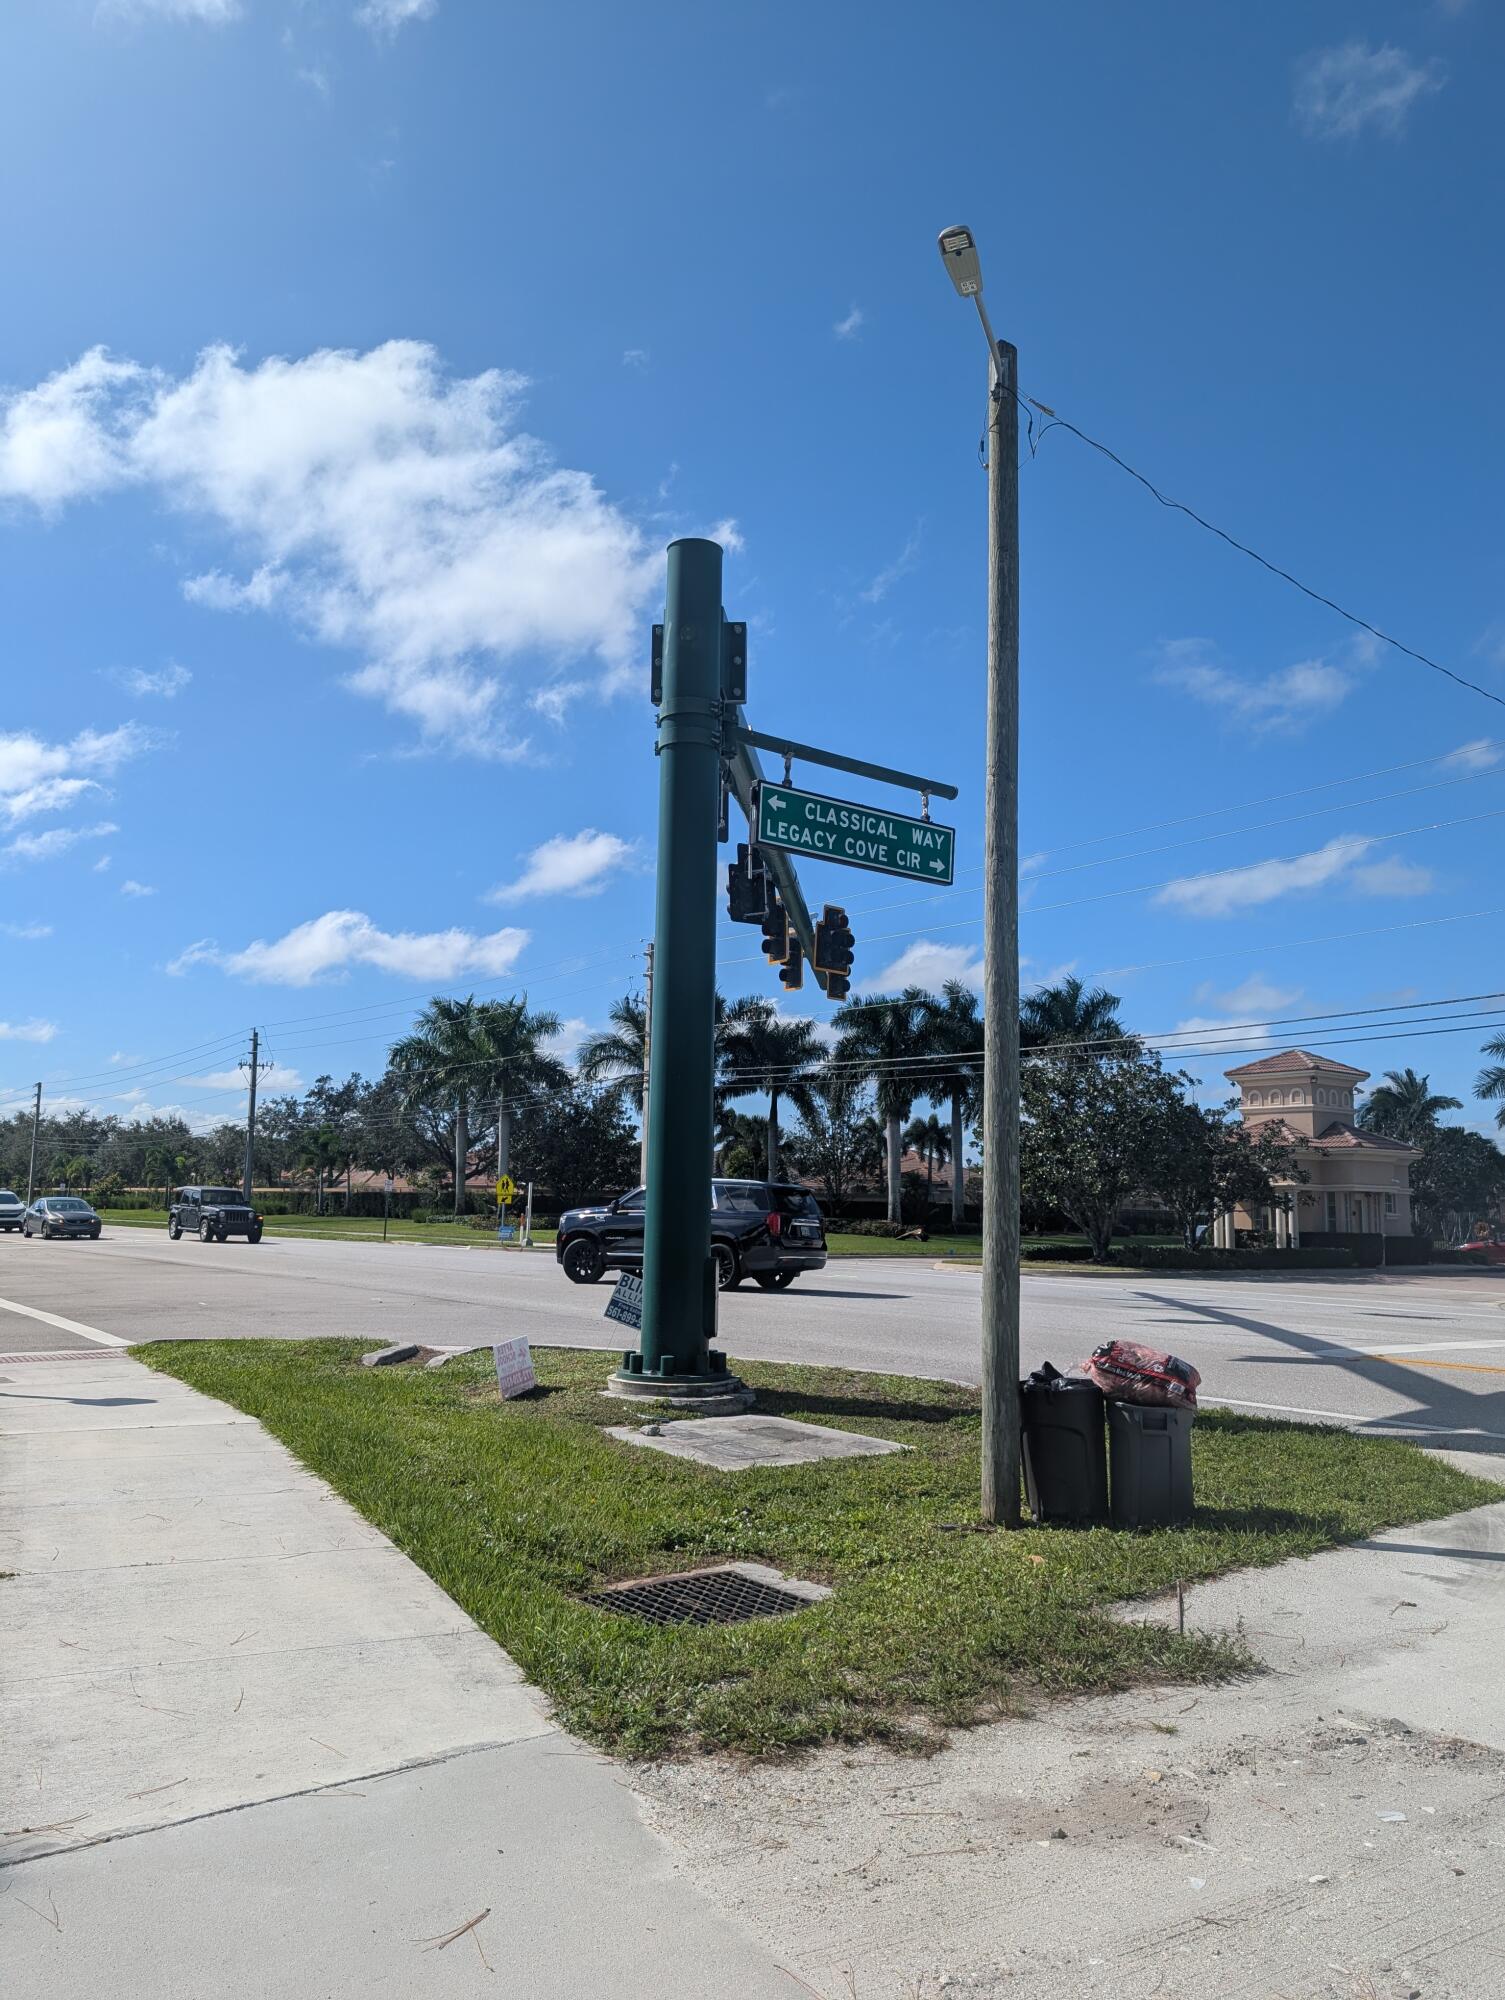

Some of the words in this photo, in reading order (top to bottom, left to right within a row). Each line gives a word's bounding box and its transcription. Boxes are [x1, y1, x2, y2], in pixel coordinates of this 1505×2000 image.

[766, 818, 837, 850] LEGACY
[845, 837, 888, 862] COVE
[896, 849, 921, 869] CIR
[805, 802, 898, 840] CLASSICAL
[912, 827, 945, 850] WAY
